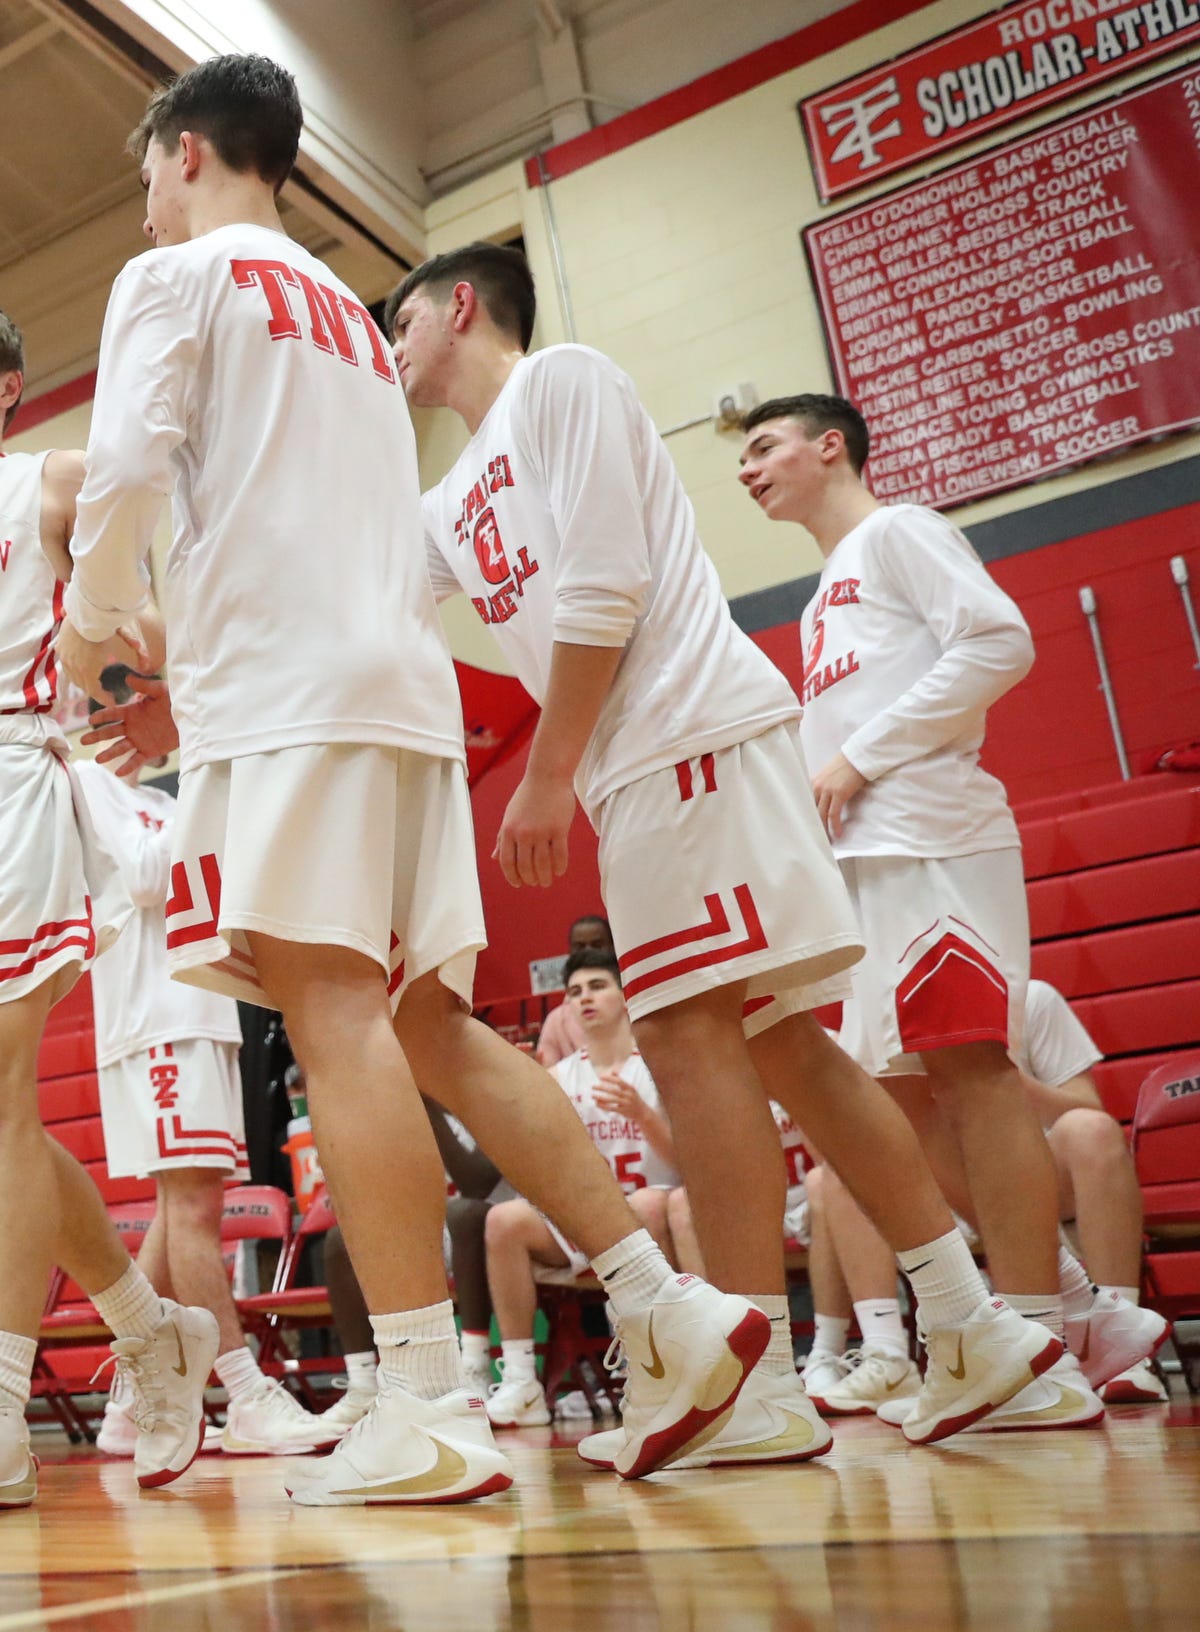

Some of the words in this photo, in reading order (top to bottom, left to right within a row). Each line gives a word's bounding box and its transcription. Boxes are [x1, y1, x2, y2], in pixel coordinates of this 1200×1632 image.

[917, 0, 1200, 137] SCHOLAR-ATHL
[998, 0, 1133, 48] ROCK
[819, 215, 870, 249] KELLI
[872, 169, 980, 227] O'DONOHUE
[994, 110, 1128, 177] BASKETBALL
[824, 204, 949, 266] CHRISTOPHER
[952, 167, 1036, 215] HOLIHAN
[1051, 126, 1138, 173] SOCCER
[828, 253, 879, 286] SARA
[963, 191, 1030, 229] CROSS
[1032, 150, 1128, 201] COUNTRY
[832, 271, 887, 303] EMMA
[886, 180, 1106, 282] MILLER-BEDELL-TRACK
[836, 288, 892, 322] BRIAN
[893, 196, 1128, 299] CONNOLLY-BASKETBALL
[840, 301, 909, 342] BRITTNI
[911, 216, 1134, 313] ALEXANDER-SOFTBALL
[230, 259, 396, 385] TNT
[846, 318, 919, 360] JORDAN
[925, 257, 1076, 330] PARDO-SOCCER
[848, 335, 927, 378] MEAGAN
[929, 307, 1004, 348] CARLEY
[1018, 252, 1152, 316] BASKETBALL
[854, 363, 919, 401] JACKIE
[920, 315, 1049, 376] CARBONETTO
[1064, 274, 1163, 323] BOWLING
[967, 359, 1051, 401] POLLACK
[1064, 329, 1129, 367] CROSS
[1132, 305, 1200, 342] COUNT
[860, 384, 919, 419] JUSTIN
[920, 361, 988, 397] REITER
[1000, 325, 1078, 371] SOCCER
[869, 447, 926, 478] KIERA
[926, 423, 994, 462] BRADY
[1007, 373, 1140, 433] BASKETBALL
[956, 390, 1027, 427] YOUNG
[1040, 338, 1174, 398] GYMNASTICS
[872, 463, 931, 497] KELLY
[933, 437, 1016, 479] FISCHER
[1027, 407, 1099, 447] TRACK
[934, 451, 1042, 500] LONIEWSKI
[1054, 415, 1140, 460] SOCCER
[605, 1151, 648, 1197] 5
